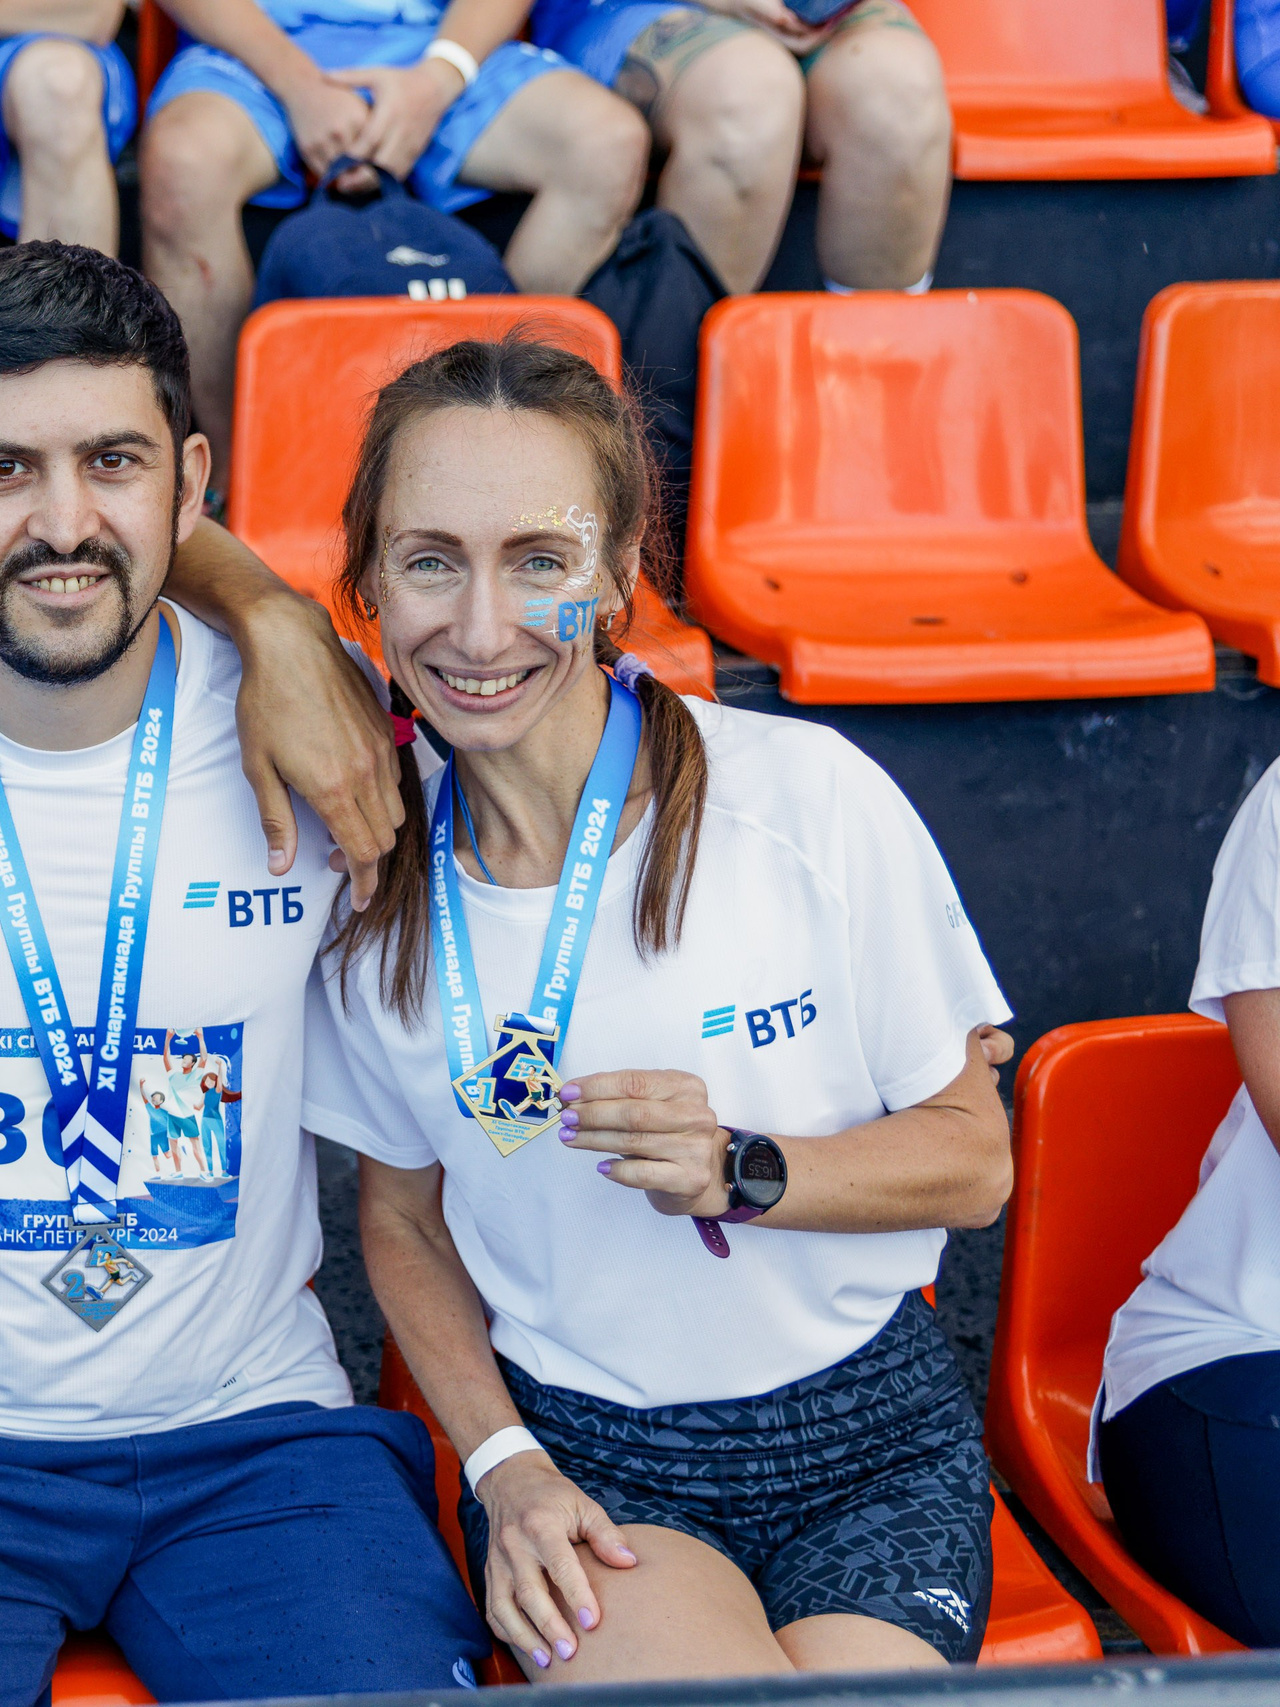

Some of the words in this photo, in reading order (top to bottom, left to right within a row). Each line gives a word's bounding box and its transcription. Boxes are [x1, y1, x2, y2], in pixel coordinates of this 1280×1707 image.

[140, 707, 163, 766] 2024
[131, 771, 154, 819] ВТБ
[434, 820, 447, 845] XI
[119, 826, 146, 909] Группы
[227, 886, 304, 928] ВТБ
[543, 916, 579, 1001] Группы
[565, 862, 593, 911] ВТБ
[580, 797, 612, 858] 2024
[433, 850, 465, 999] Спартакиада
[8, 891, 42, 975] Группы
[32, 977, 61, 1025] ВТБ
[47, 1028, 78, 1087] 2024
[100, 911, 136, 1062] Спартакиада
[745, 988, 817, 1049] ВТБ
[96, 1066, 118, 1093] XI
[478, 1082, 493, 1109] 1
[23, 1214, 69, 1228] ГРУП
[138, 1228, 178, 1242] 2024
[66, 1273, 84, 1297] 2
[913, 1589, 970, 1634] ATHLEX
